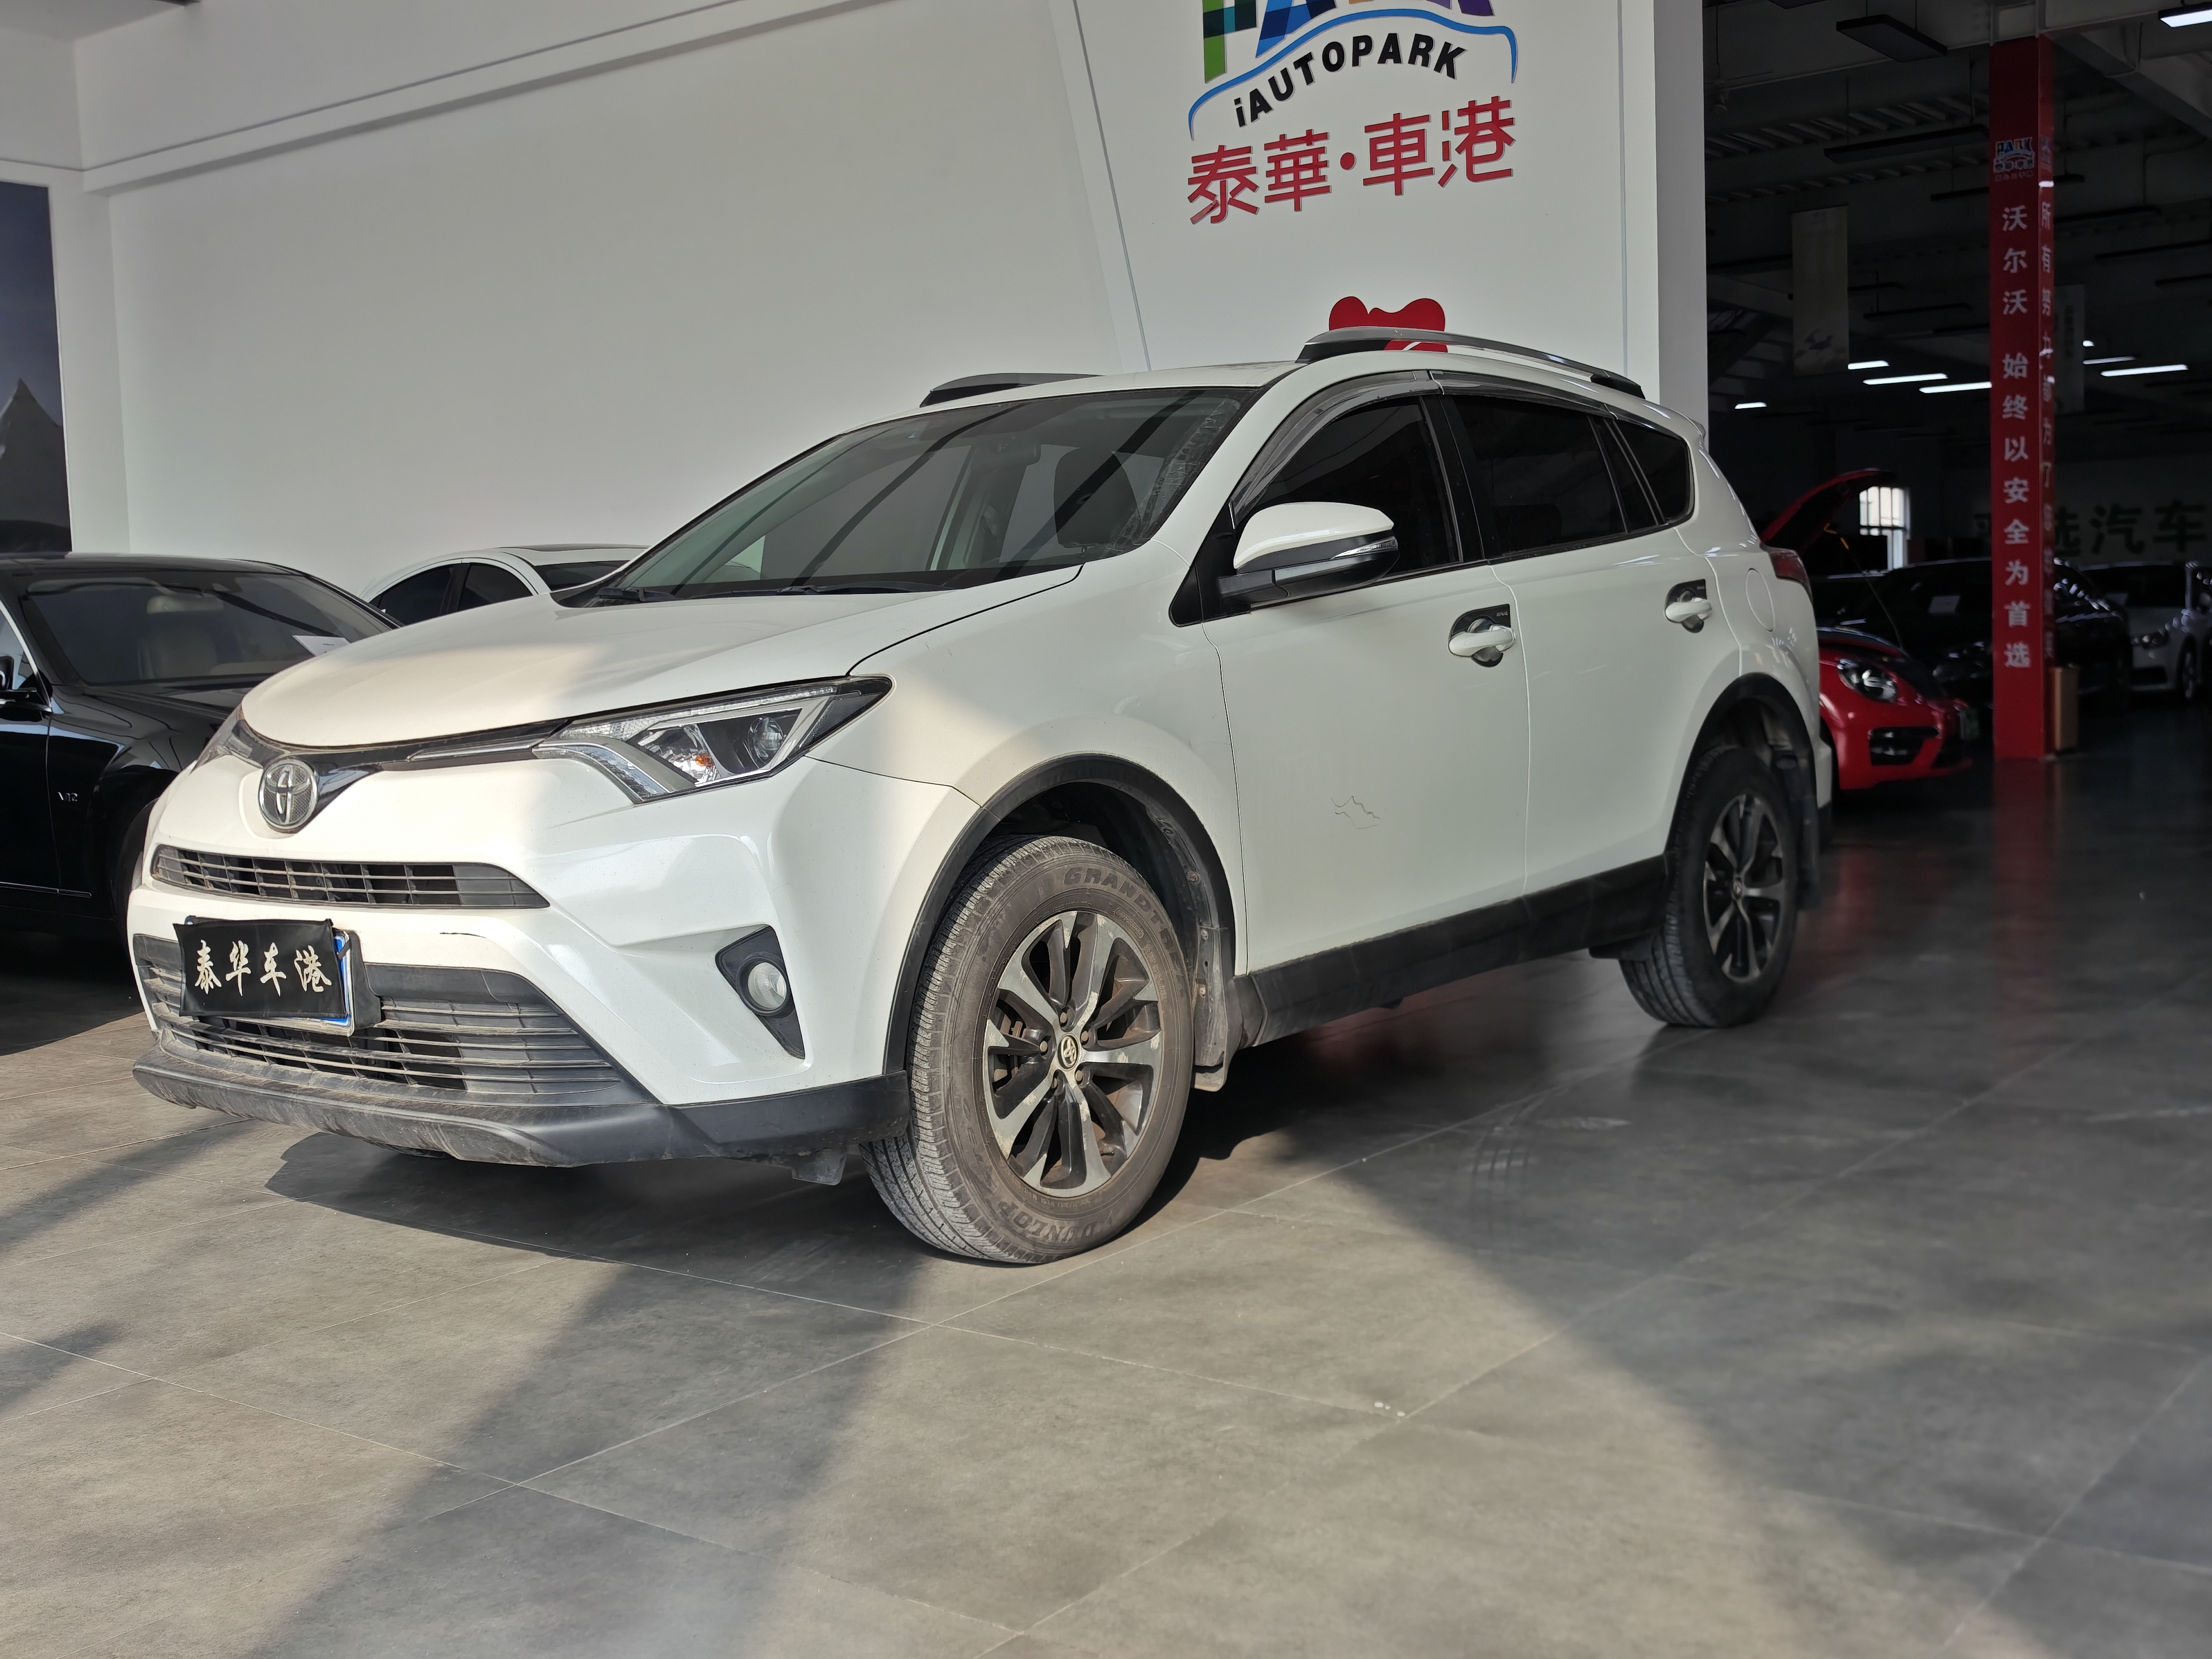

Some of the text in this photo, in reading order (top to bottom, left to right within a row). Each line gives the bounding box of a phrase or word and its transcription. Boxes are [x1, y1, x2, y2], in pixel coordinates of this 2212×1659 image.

[1234, 33, 1466, 127] iAUTOPARK
[57, 792, 78, 802] V12
[194, 940, 332, 997] 泰华车港
